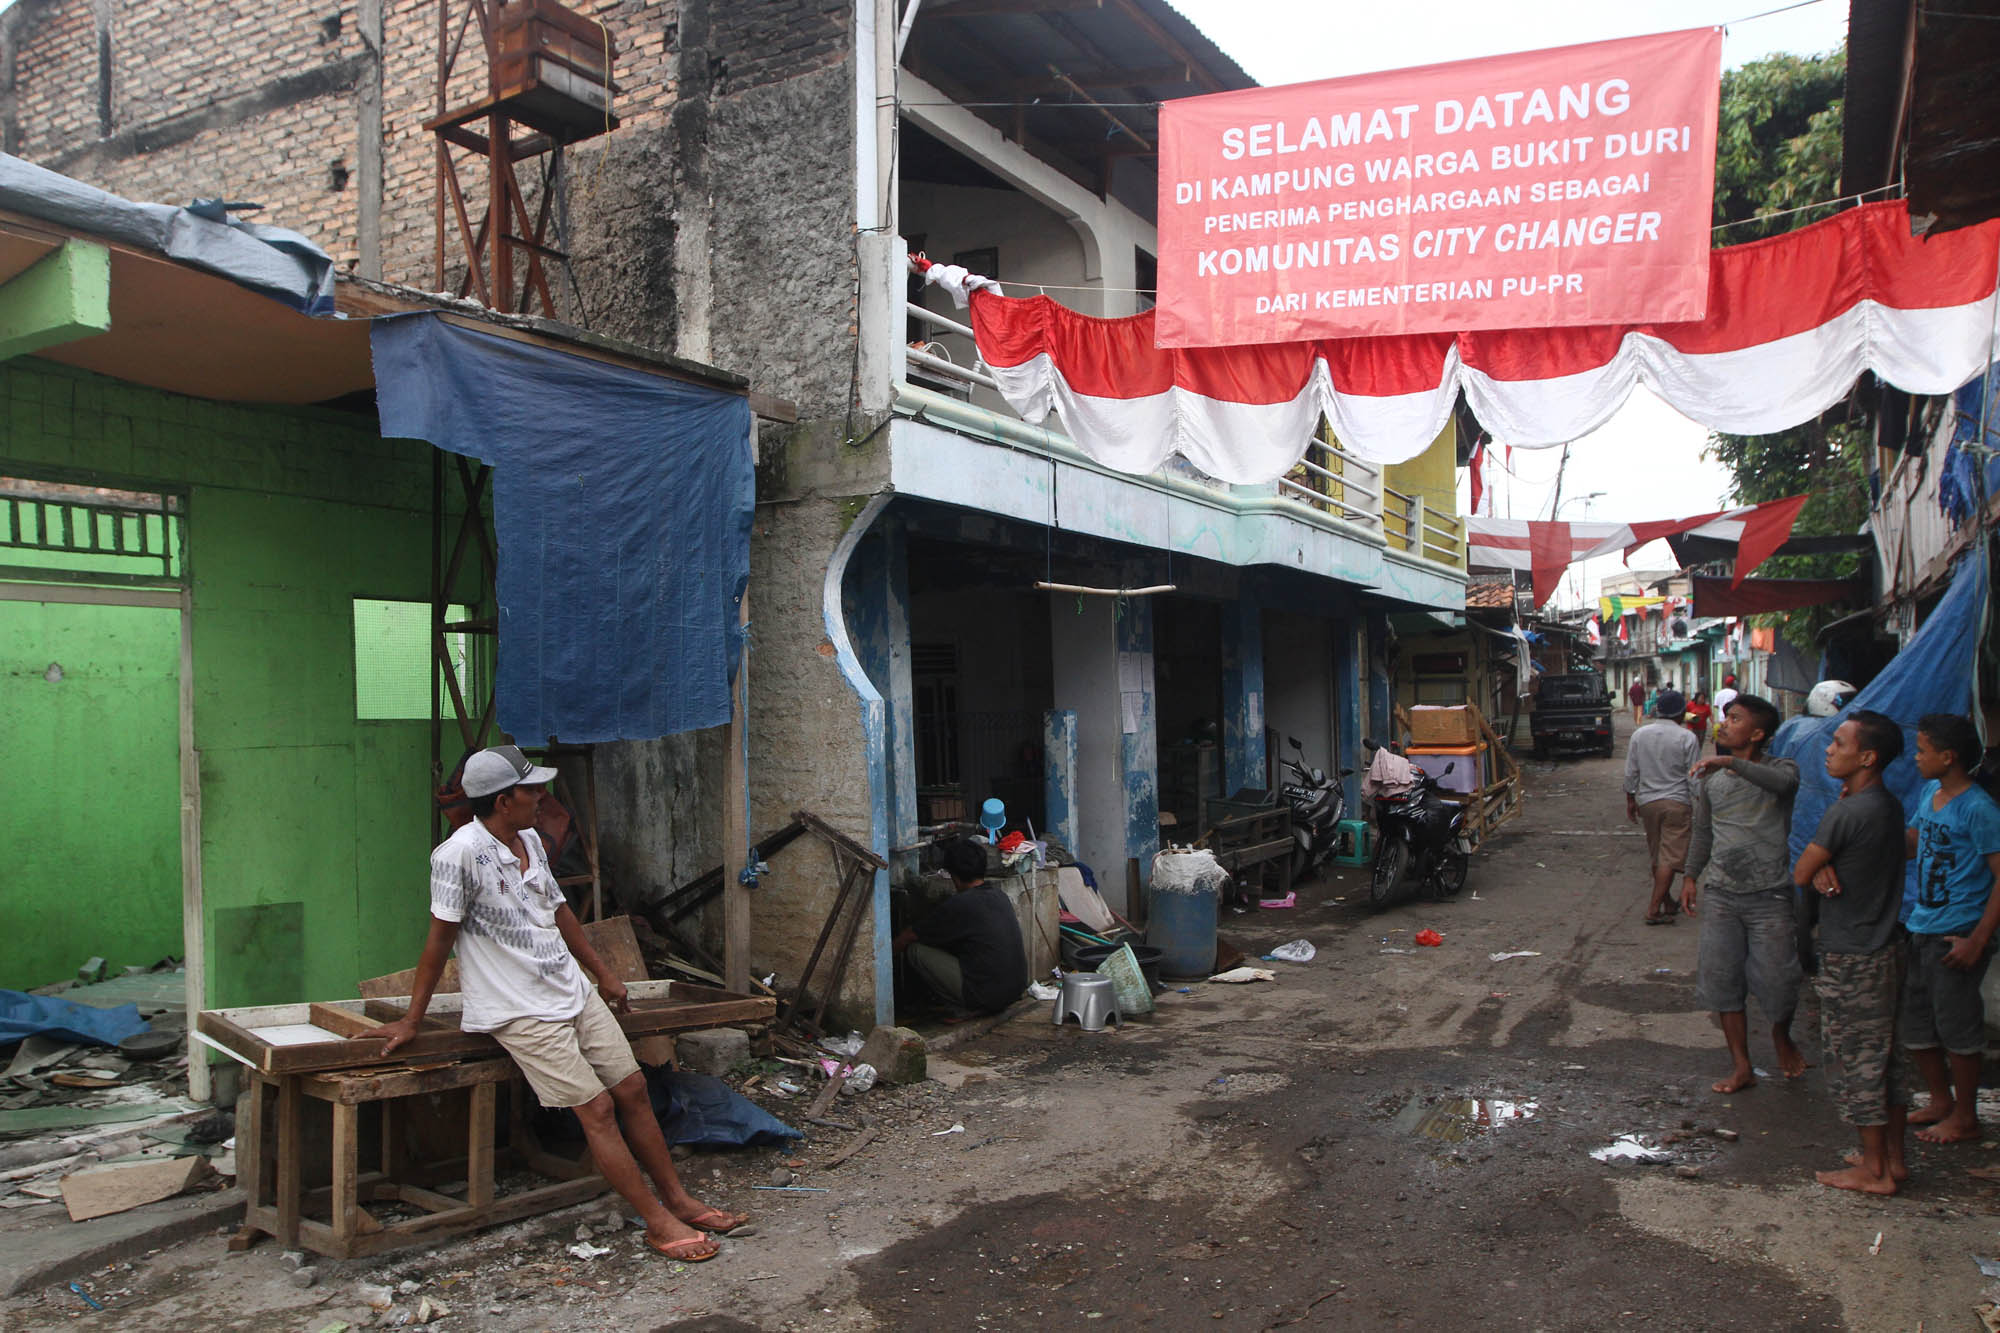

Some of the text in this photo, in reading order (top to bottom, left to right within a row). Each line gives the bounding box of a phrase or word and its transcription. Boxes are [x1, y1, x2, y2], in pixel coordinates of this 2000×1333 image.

[1221, 78, 1631, 161] SELAMAT DATANG
[1175, 125, 1690, 205] DI KAMPUNG WARGA BUKIT DURI
[1204, 171, 1650, 235] PENERIMA PENGHARGAAN SEBAGAI
[1197, 211, 1662, 278] KOMUNITAS CITY CHANGER
[1255, 273, 1583, 315] DARI KEMENTERIAN PU-PR
